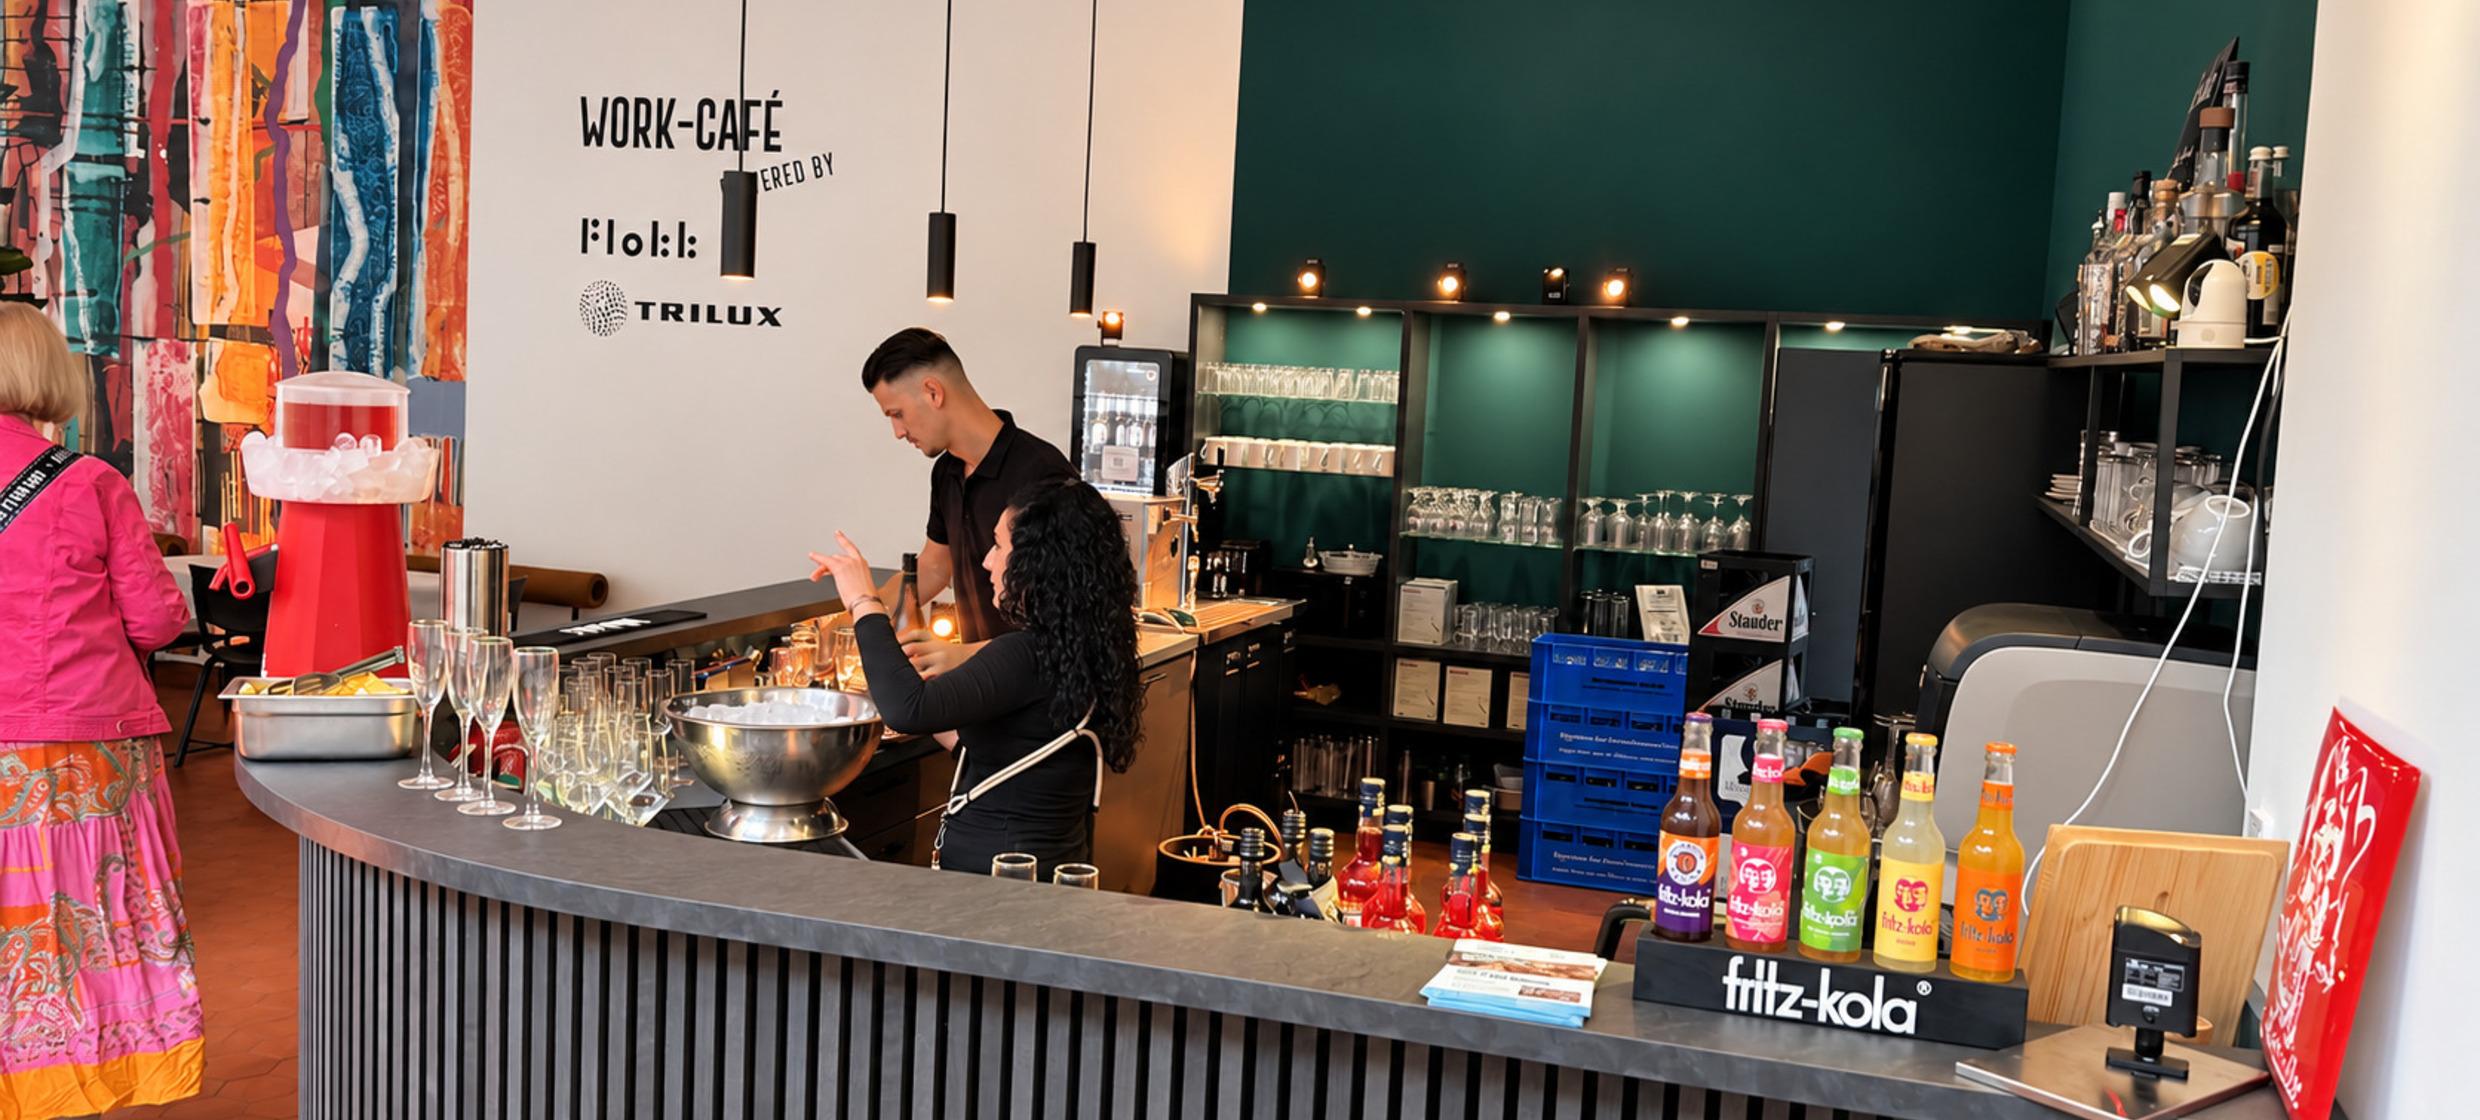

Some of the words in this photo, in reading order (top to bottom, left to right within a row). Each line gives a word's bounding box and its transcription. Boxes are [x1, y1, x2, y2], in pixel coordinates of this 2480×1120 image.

[580, 89, 783, 152] WORK-CAFÉ
[757, 160, 805, 192] ERED
[811, 152, 833, 179] BY
[634, 301, 783, 327] TRILUX
[1728, 610, 1783, 631] Stauder
